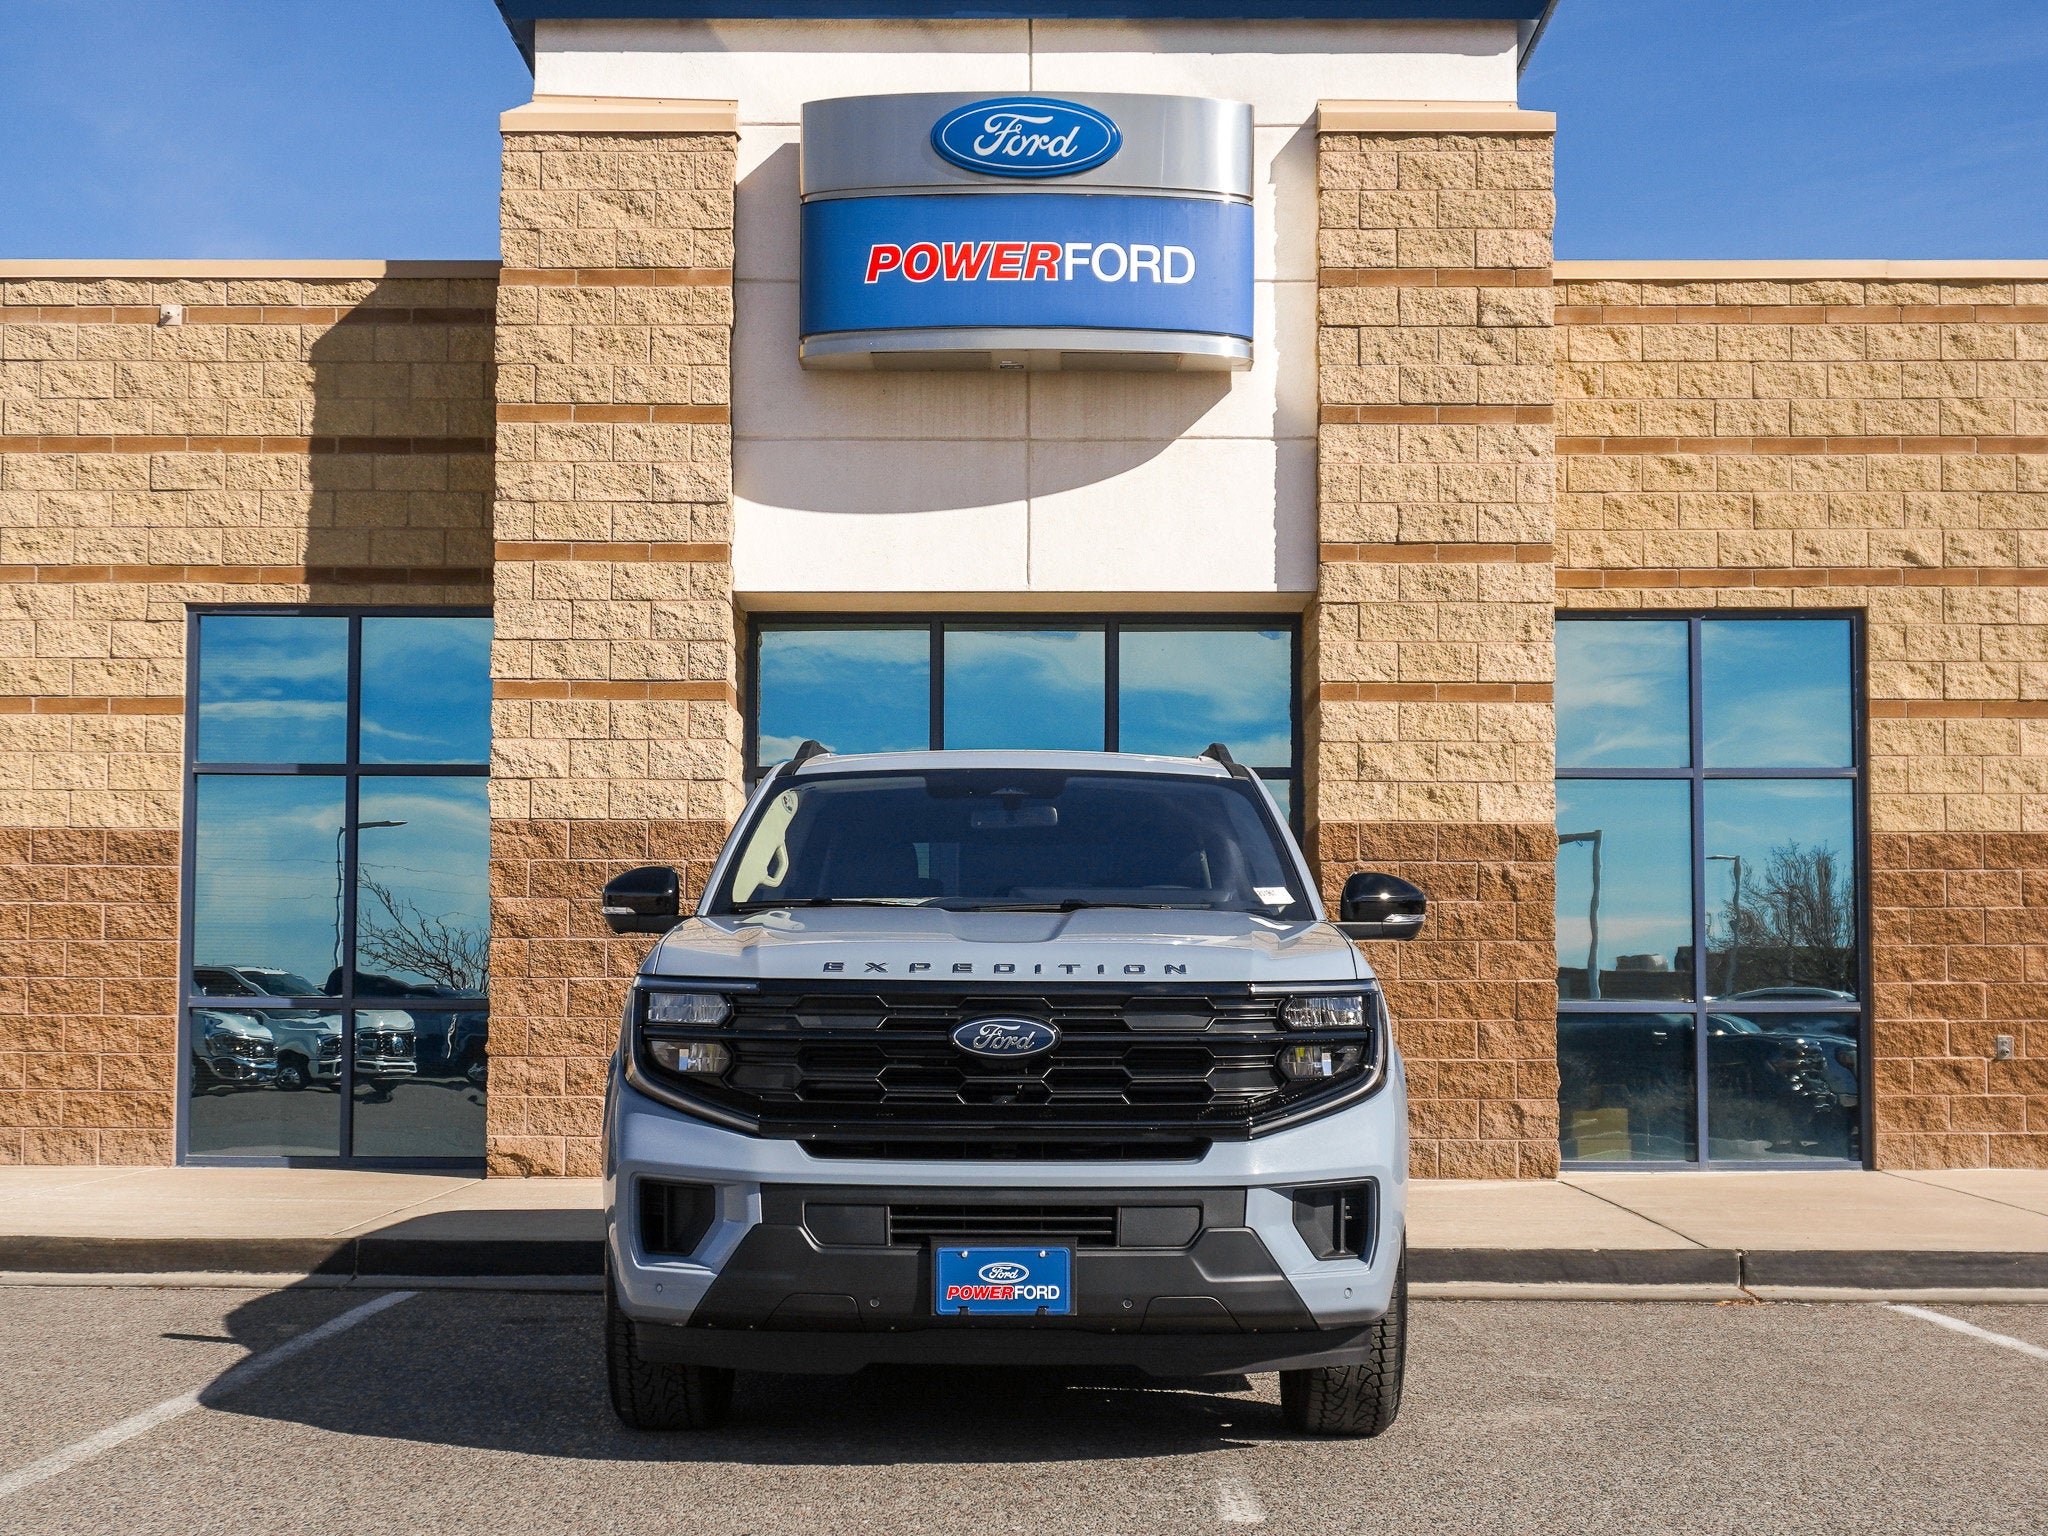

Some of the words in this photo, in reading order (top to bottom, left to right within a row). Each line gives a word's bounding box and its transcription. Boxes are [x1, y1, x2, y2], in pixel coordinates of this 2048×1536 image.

[973, 112, 1081, 157] Ford
[822, 961, 1188, 975] EXPEDITION
[972, 1024, 1035, 1051] Ford
[988, 1266, 1019, 1280] Ford
